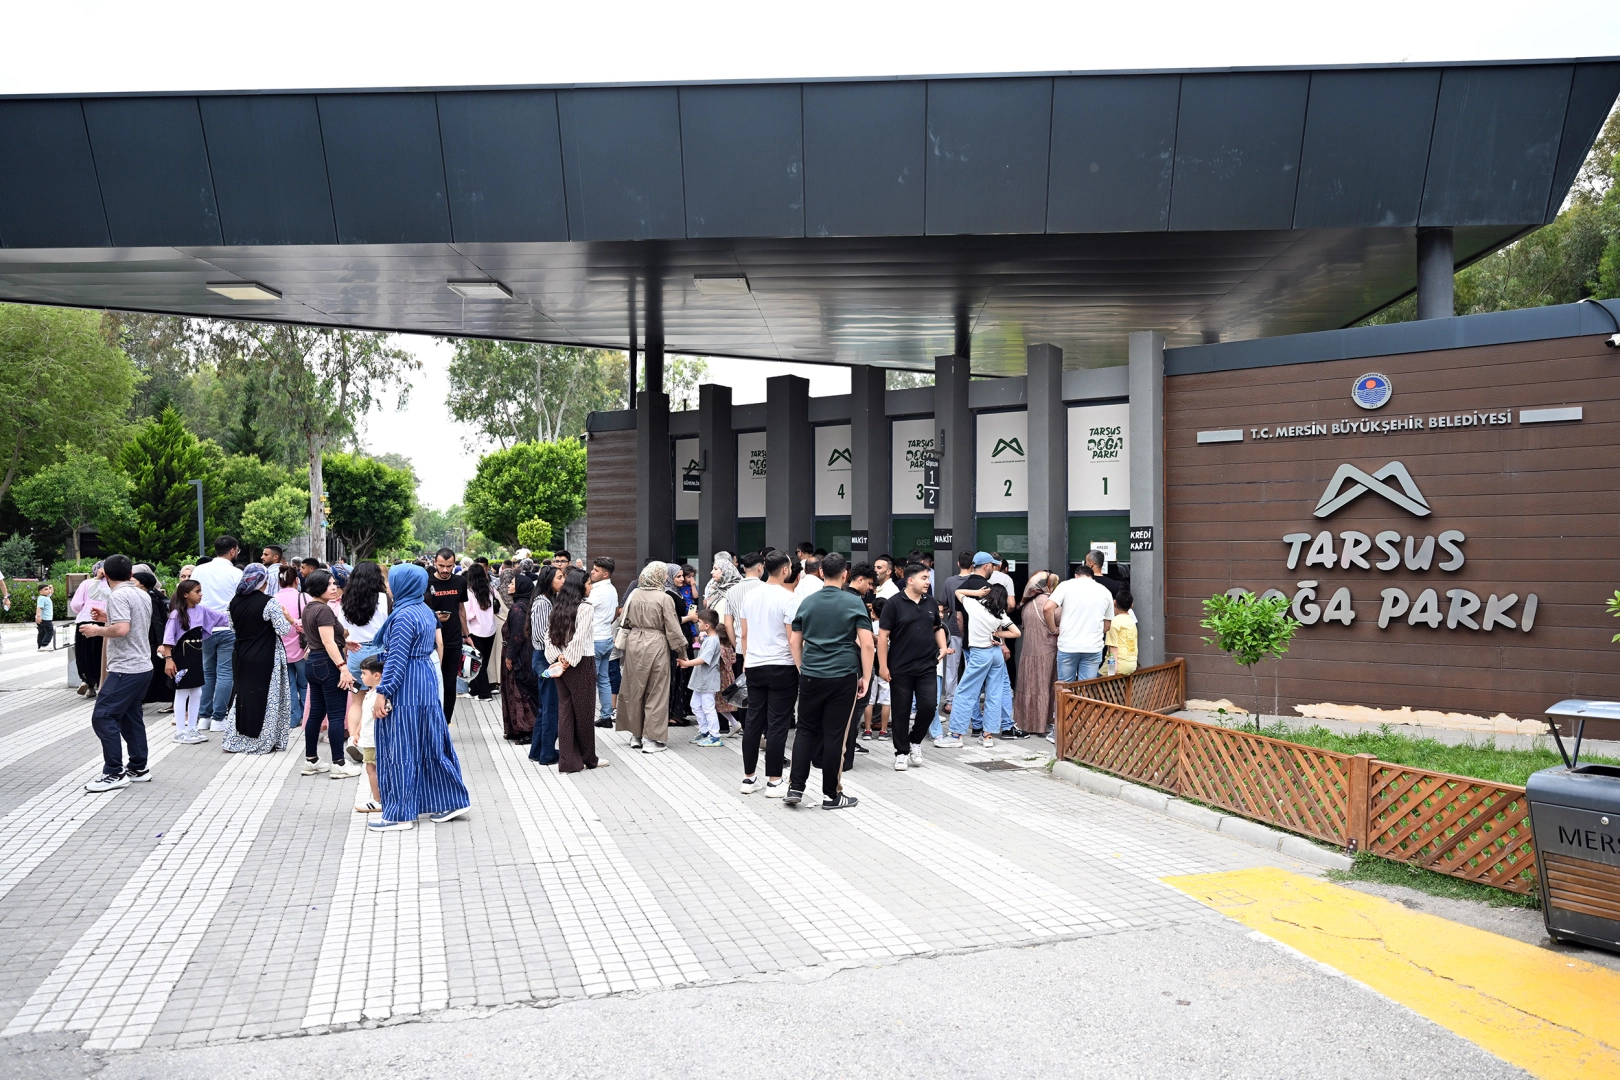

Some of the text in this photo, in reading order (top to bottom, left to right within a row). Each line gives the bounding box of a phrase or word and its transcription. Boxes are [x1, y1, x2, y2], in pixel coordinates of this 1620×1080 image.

[1089, 426, 1121, 436] TARSUS
[1251, 409, 1512, 439] T.C. MERSİN BÜYÜKŞEHİR BELEDİYESİ
[908, 439, 934, 448] TARSUS
[1092, 450, 1119, 459] PARKI
[930, 470, 935, 484] 1
[837, 483, 845, 499] 4
[916, 483, 924, 500] 3
[1004, 479, 1012, 496] 2
[1102, 477, 1108, 495] 1
[929, 490, 935, 504] 2
[934, 533, 953, 543] NAKİT
[1130, 529, 1152, 539] KREDİ
[1130, 541, 1152, 550] KARTI
[1282, 529, 1466, 572] TARSUS
[1226, 580, 1538, 633] ĞA PARKI
[1558, 825, 1620, 855] MER
